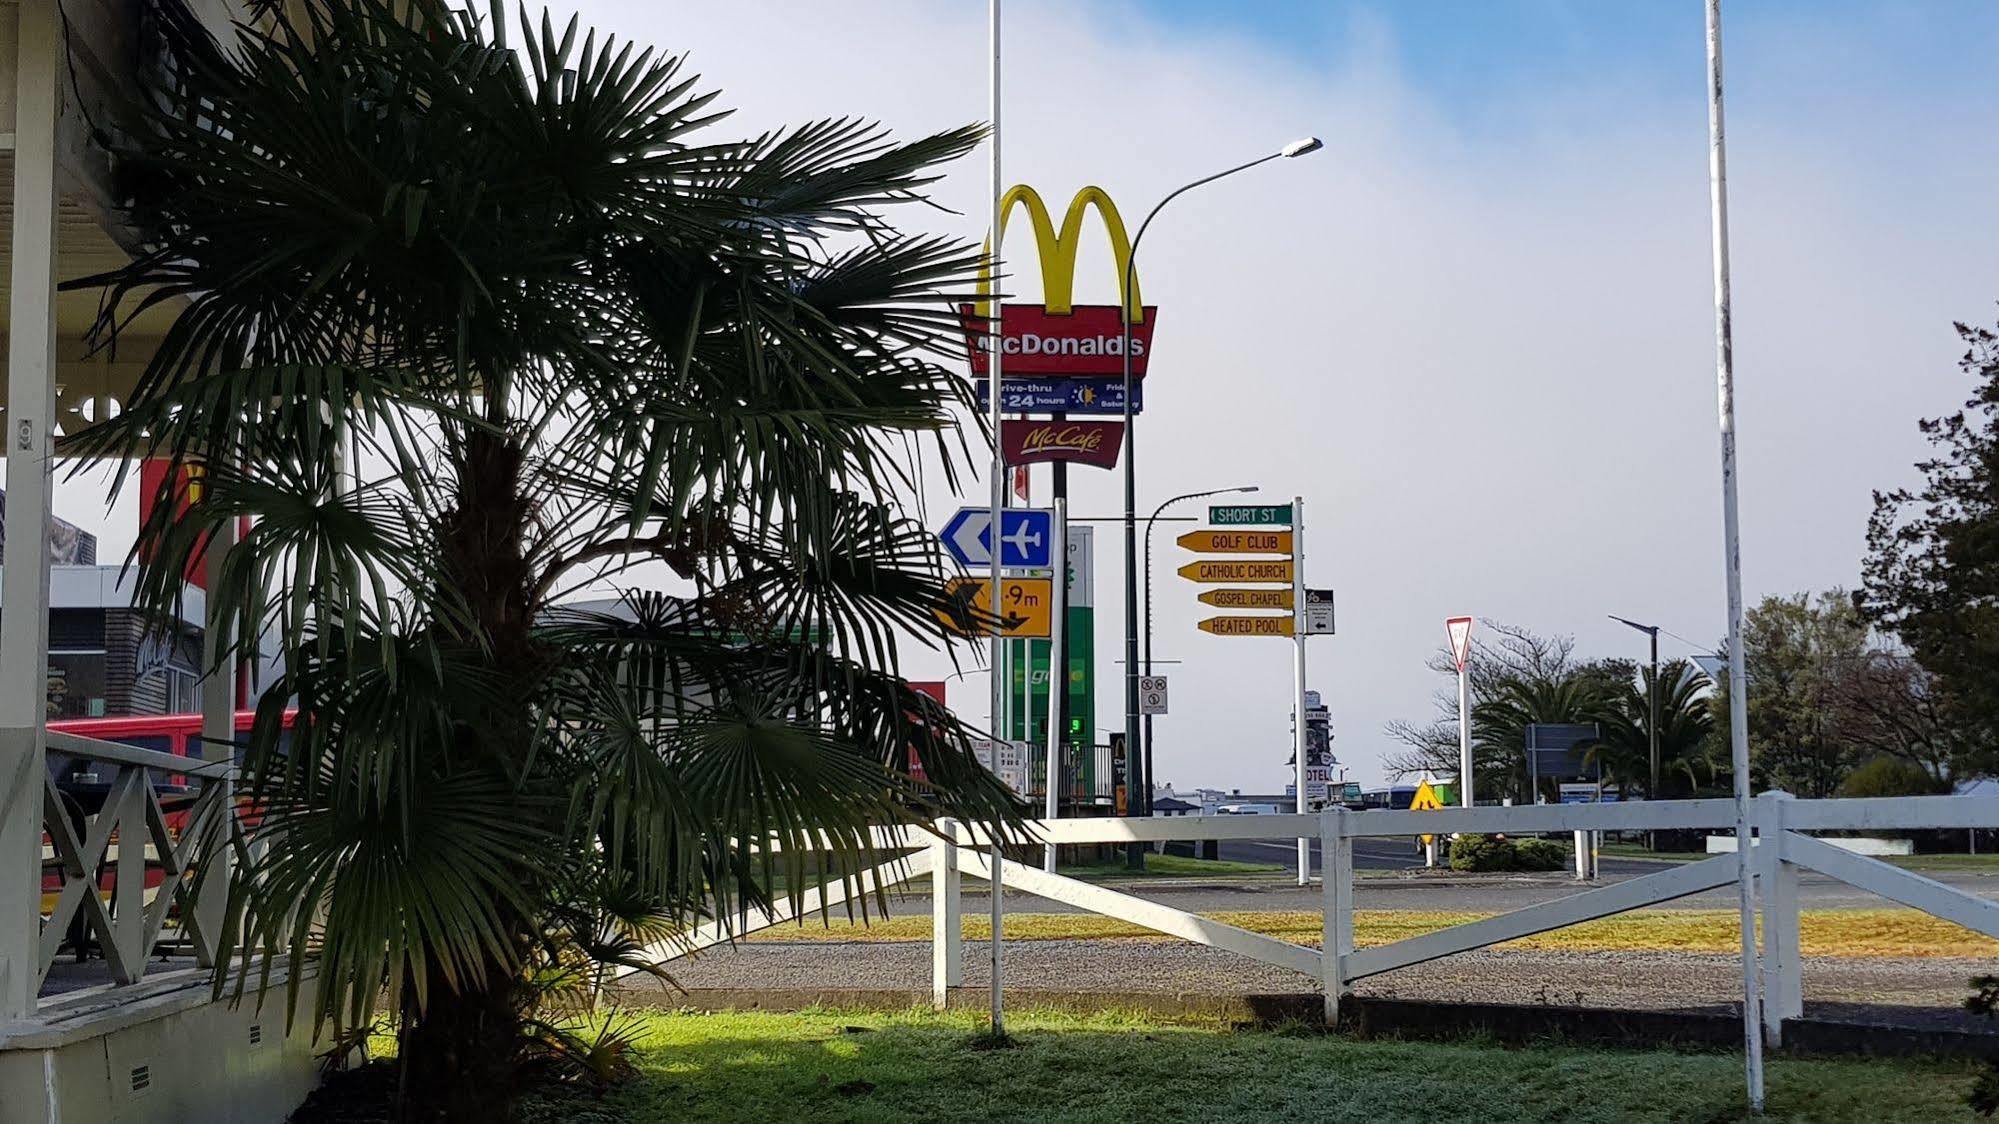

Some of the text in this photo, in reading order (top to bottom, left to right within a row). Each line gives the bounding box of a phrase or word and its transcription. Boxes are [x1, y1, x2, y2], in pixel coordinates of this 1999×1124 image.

[977, 333, 1145, 355] McDonalds
[1000, 383, 1053, 393] rive-thru
[1008, 394, 1035, 407] 24
[1036, 397, 1066, 405] hours
[1218, 508, 1277, 522] SHORT ST
[1212, 535, 1279, 549] GOLF CLUB
[1200, 565, 1287, 578] CATHOLIC CHURCH
[1214, 592, 1284, 606] GOSPEL CHAPEL
[1212, 619, 1283, 633] HEATED POOL
[1306, 769, 1331, 782] OTEL
